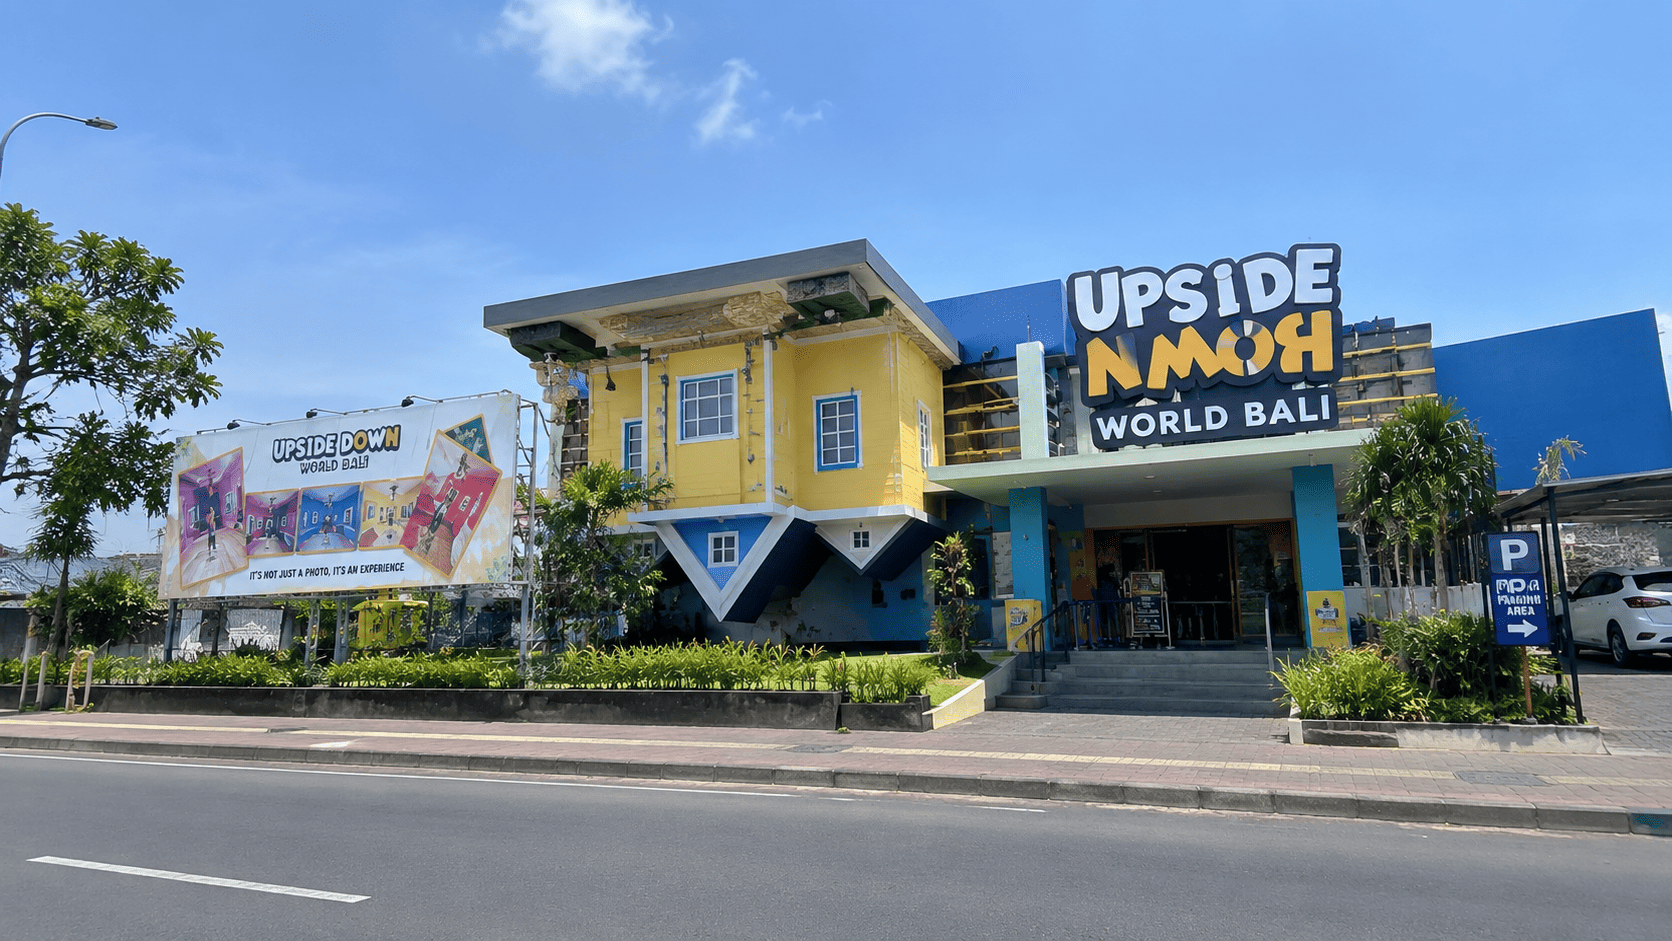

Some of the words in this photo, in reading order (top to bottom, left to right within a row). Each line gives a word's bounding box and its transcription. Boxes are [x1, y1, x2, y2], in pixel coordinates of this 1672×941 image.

[1096, 405, 1229, 441] WORLD
[1244, 394, 1331, 427] BALI
[272, 433, 338, 463] UPSIDE
[339, 424, 401, 456] DOWN
[249, 570, 262, 580] IT'S
[263, 570, 278, 579] NOT
[279, 569, 297, 578] JUST
[298, 568, 303, 577] A
[305, 567, 331, 577] PHOTO,
[333, 565, 346, 575] IT'S
[347, 565, 358, 574] AN
[360, 562, 405, 574] EXPERIENCE
[1500, 539, 1529, 571] P
[1507, 606, 1536, 616] AREA
